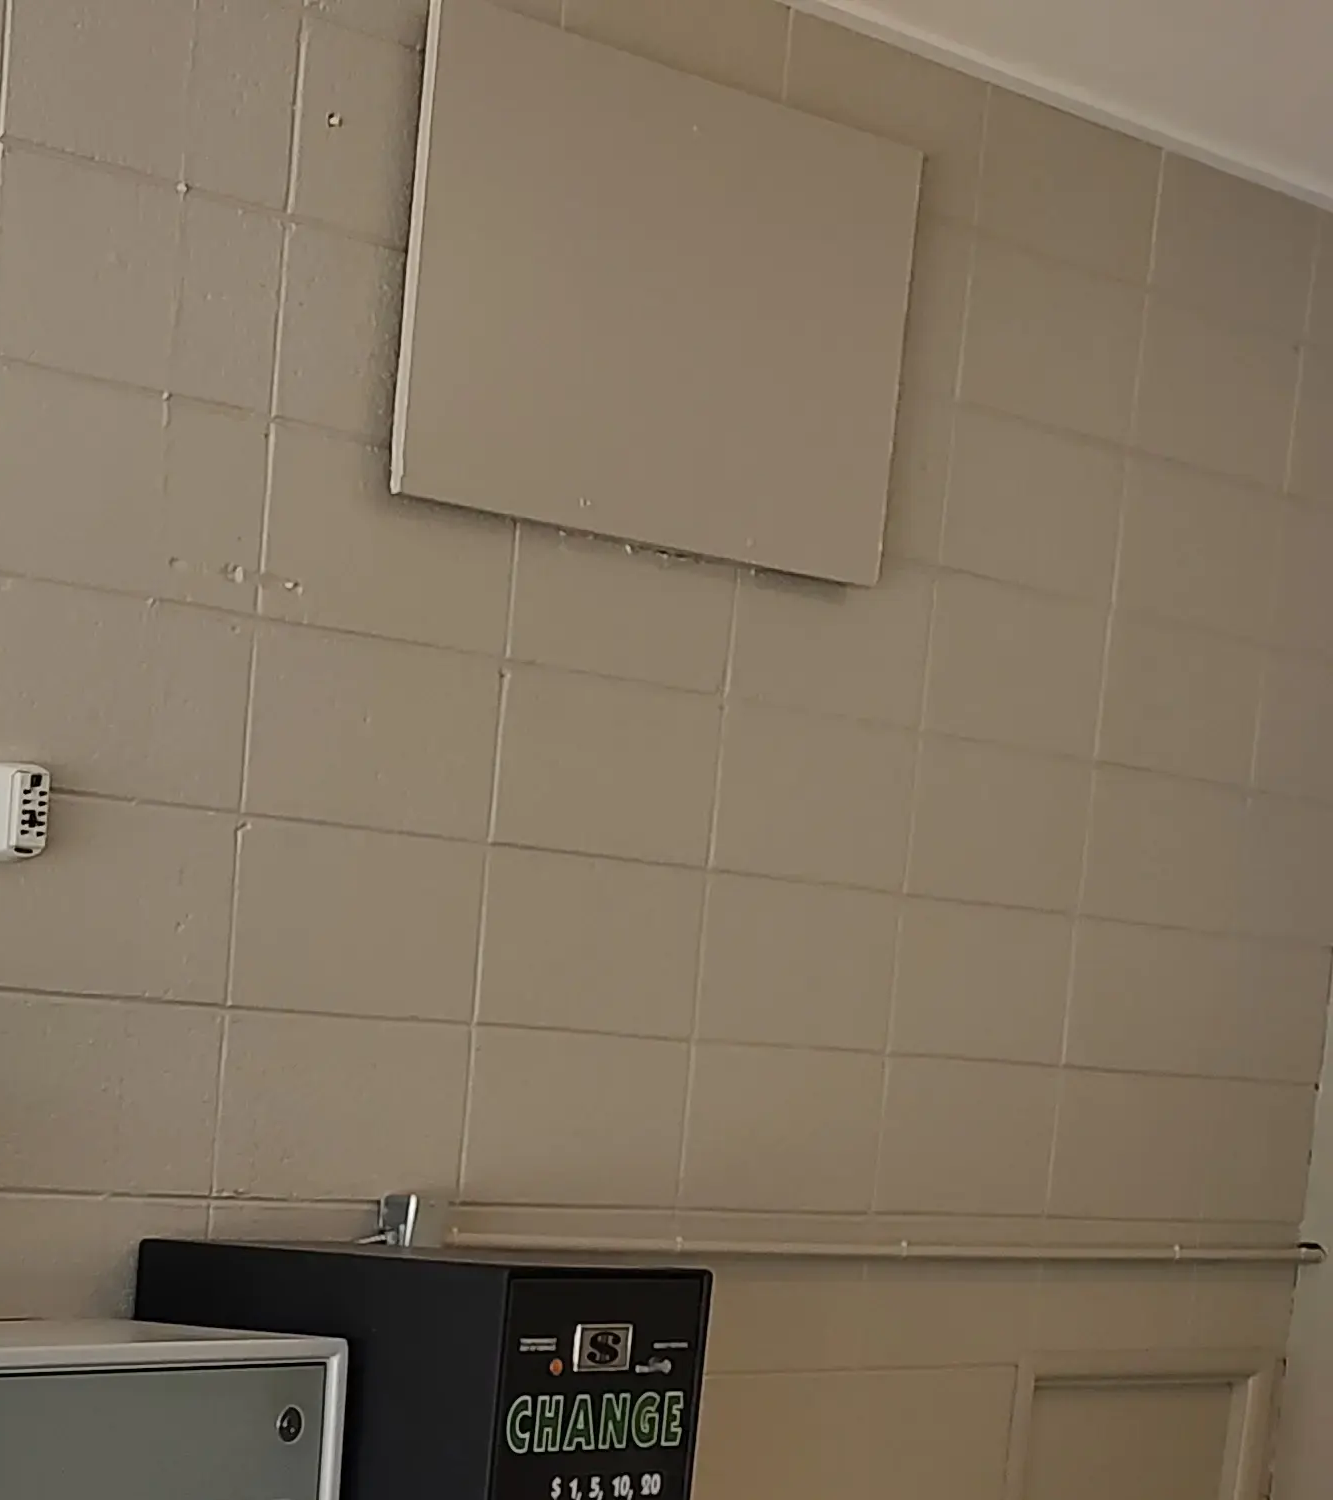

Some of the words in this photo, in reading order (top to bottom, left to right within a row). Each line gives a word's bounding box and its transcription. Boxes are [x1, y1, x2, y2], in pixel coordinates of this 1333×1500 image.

[506, 1391, 684, 1454] CHANGE
[612, 1474, 634, 1500] 10,
[640, 1473, 661, 1495] 20
